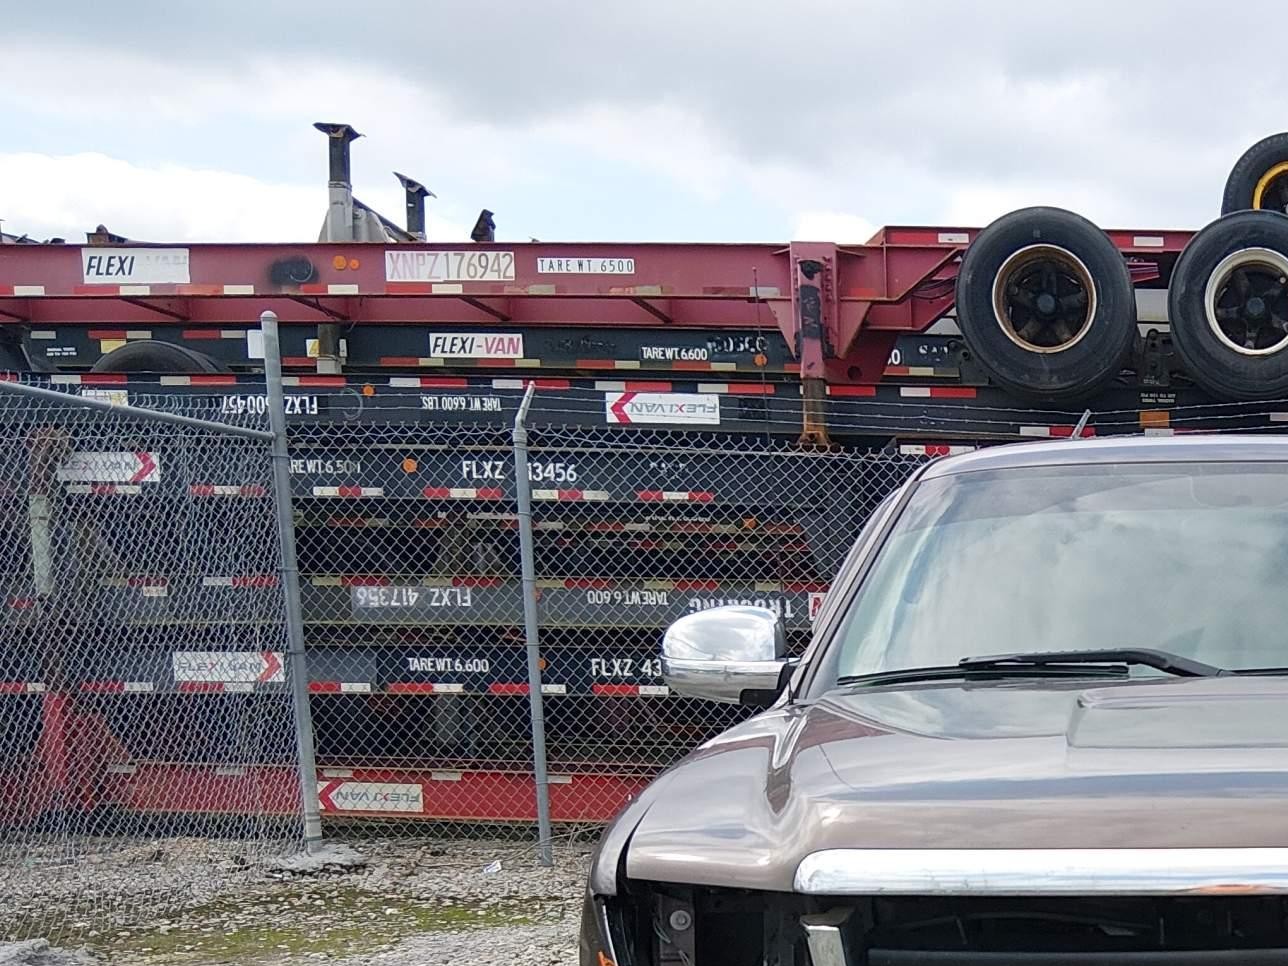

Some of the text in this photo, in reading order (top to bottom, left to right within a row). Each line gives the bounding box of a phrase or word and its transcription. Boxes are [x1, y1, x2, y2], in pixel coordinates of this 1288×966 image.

[86, 255, 135, 276] FLEXI
[540, 259, 571, 273] TARE
[600, 259, 634, 273] 6500
[432, 336, 521, 355] FLEXI-VAN
[641, 346, 664, 360] TARE
[284, 395, 318, 415] FLXZ
[482, 397, 502, 412] TARE
[630, 402, 718, 413] FLEXI VAN
[462, 461, 578, 482] FLXZ 13456
[356, 588, 472, 607] FLXZ 417356
[642, 591, 669, 606] TARE
[408, 658, 433, 672] TARE
[592, 659, 633, 677] FLXZ
[335, 791, 420, 803] FLEXI VAN
